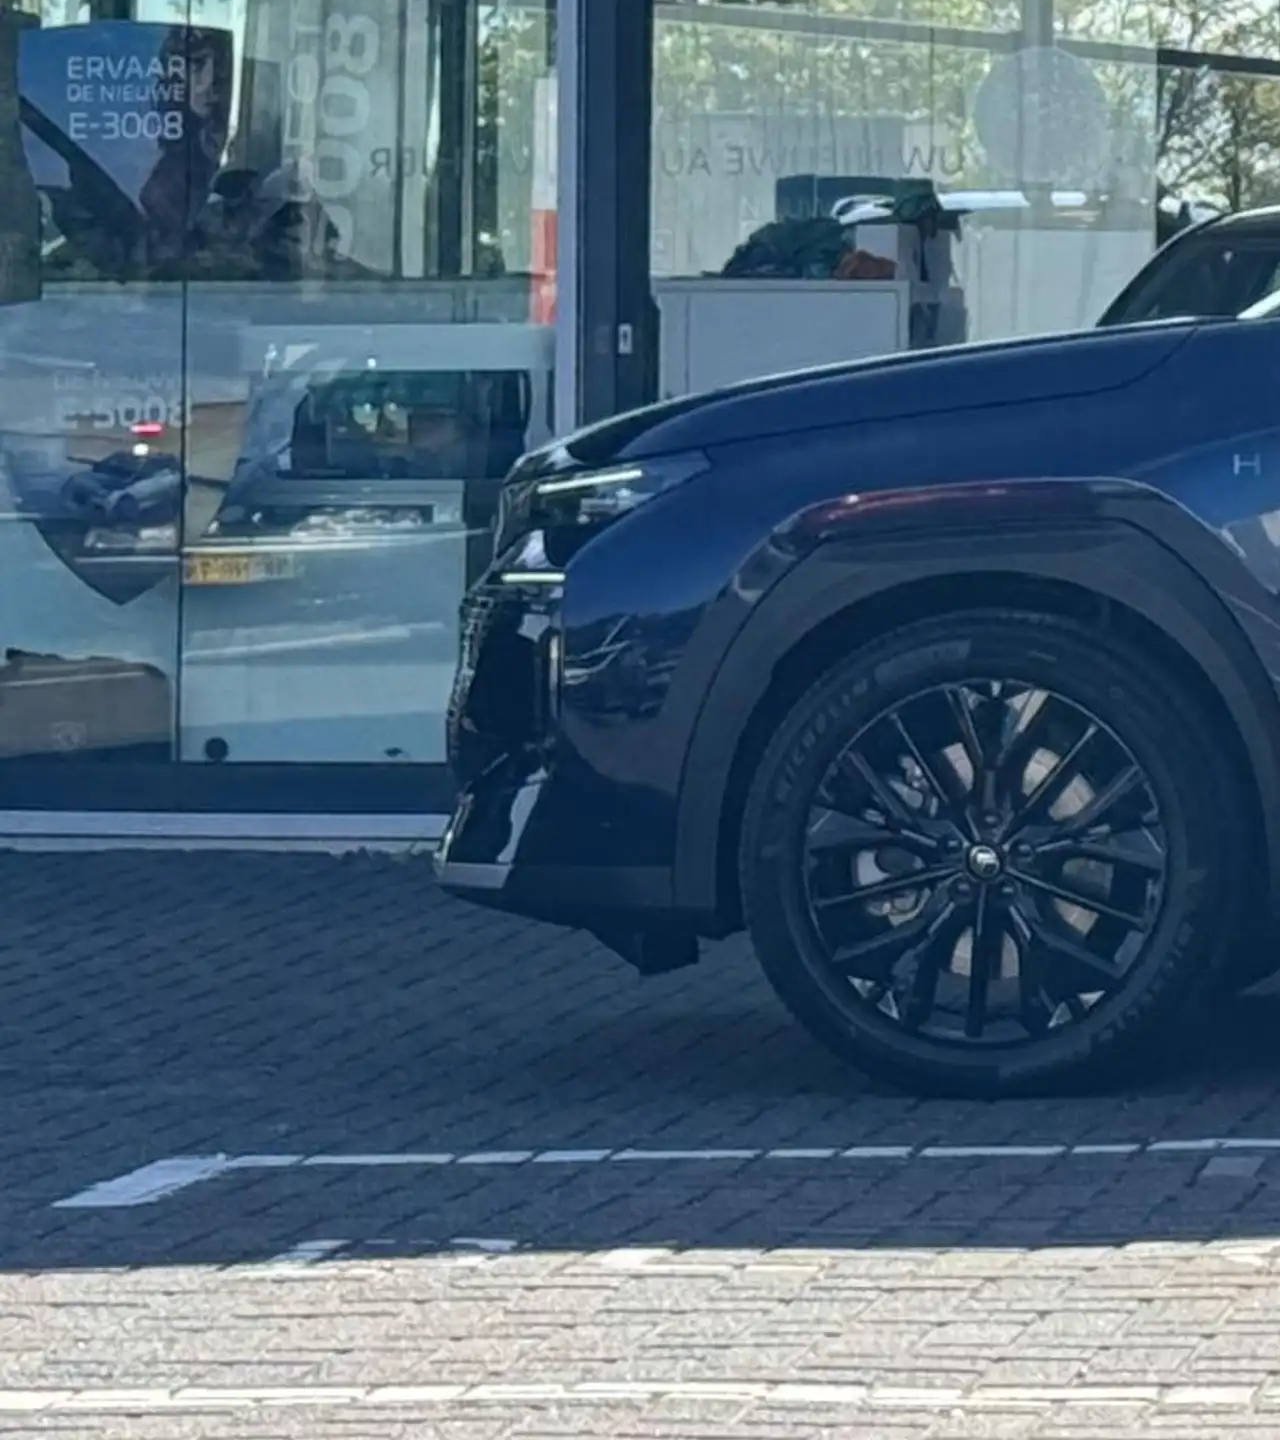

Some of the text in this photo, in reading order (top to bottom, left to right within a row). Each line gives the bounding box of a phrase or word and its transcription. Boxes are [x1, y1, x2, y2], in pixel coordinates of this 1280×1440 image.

[67, 55, 186, 80] ERVAAR
[66, 82, 186, 103] DE NIEUWE
[68, 110, 184, 140] E-3008
